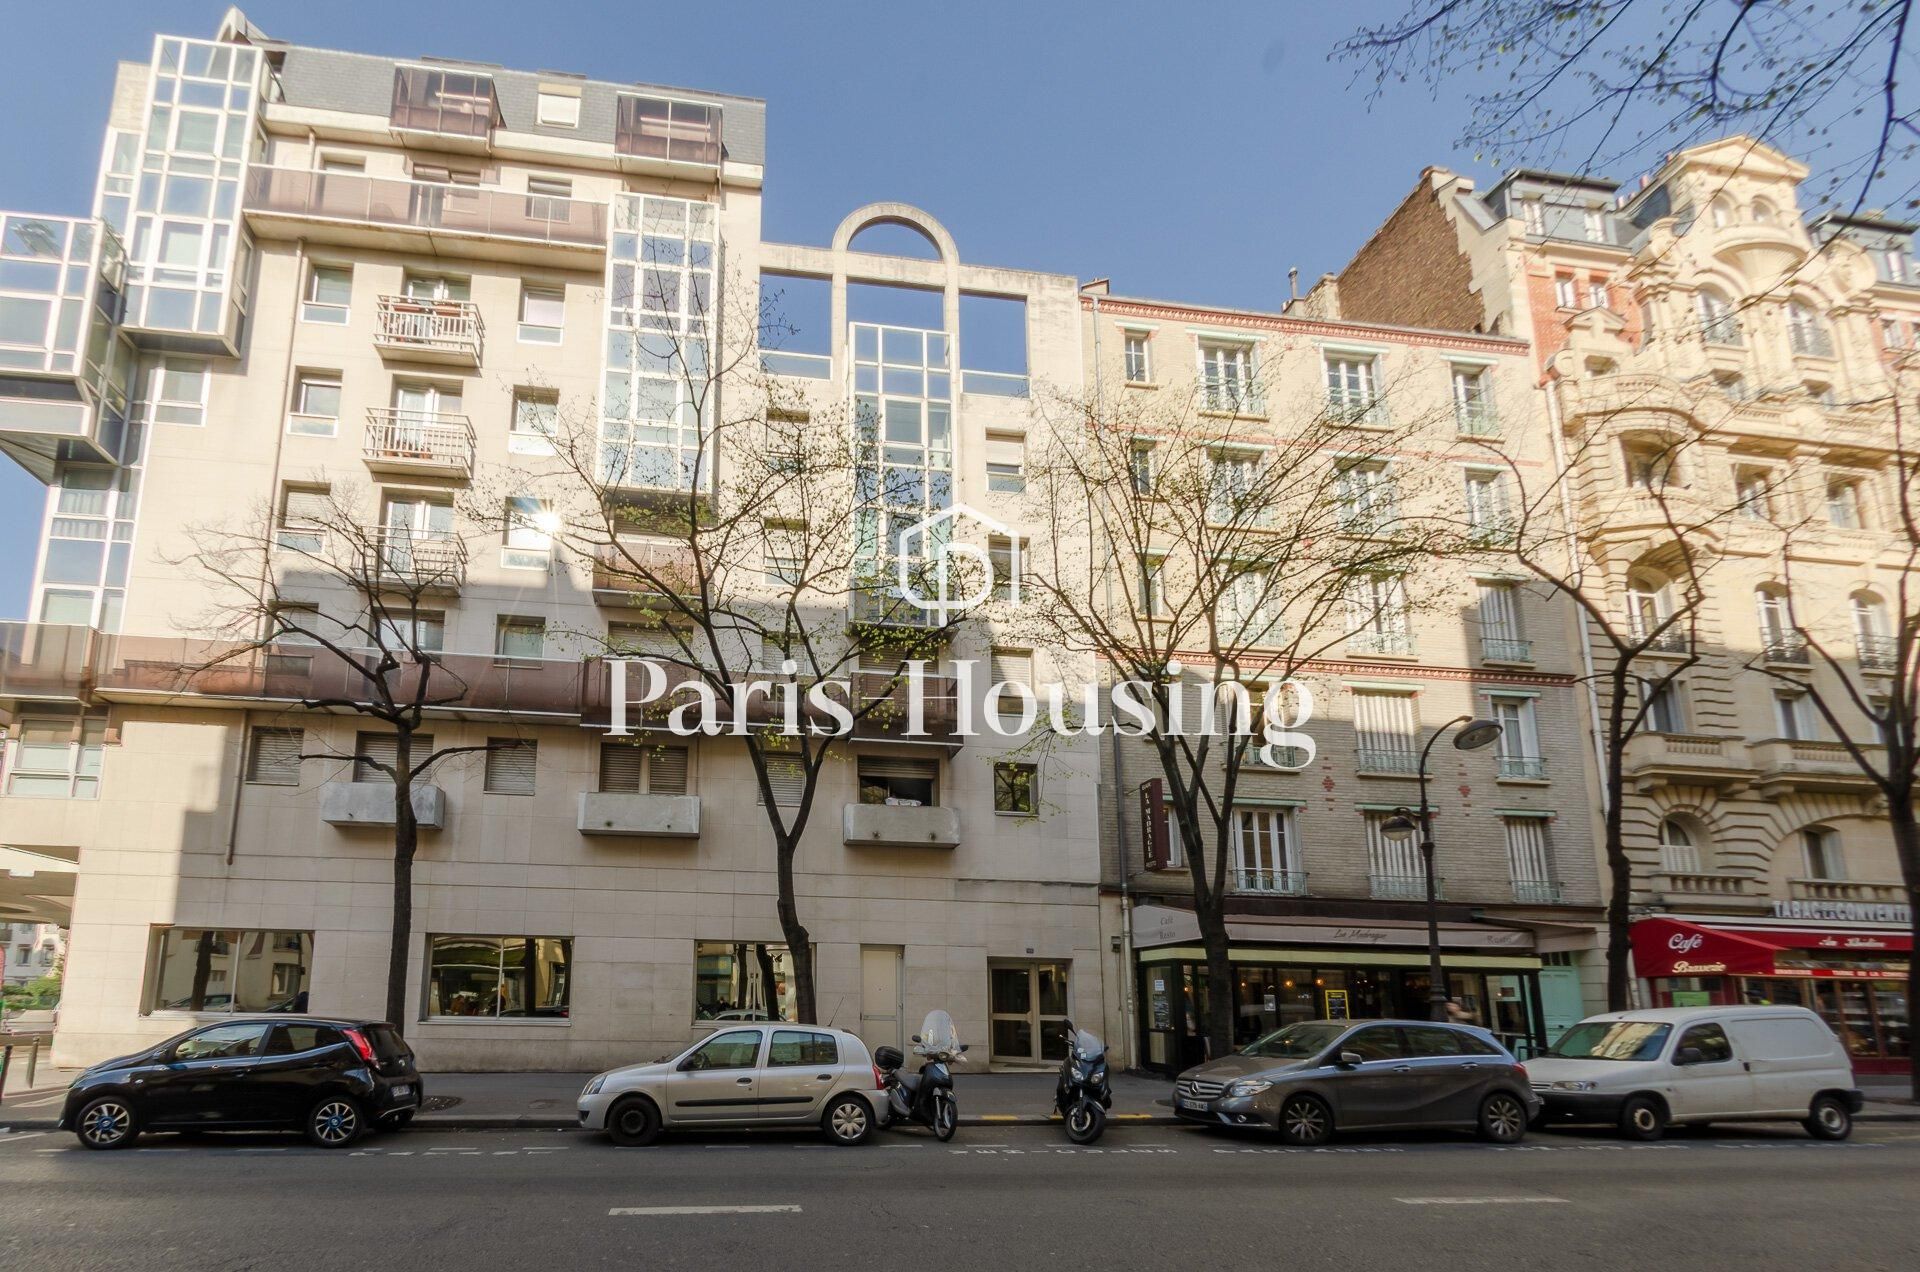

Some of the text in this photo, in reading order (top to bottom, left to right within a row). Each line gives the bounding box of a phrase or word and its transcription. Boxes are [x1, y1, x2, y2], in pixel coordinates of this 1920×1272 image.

[1160, 915, 1174, 926] Café
[1668, 933, 1703, 953] Café
[1672, 960, 1727, 973] Brasserie
